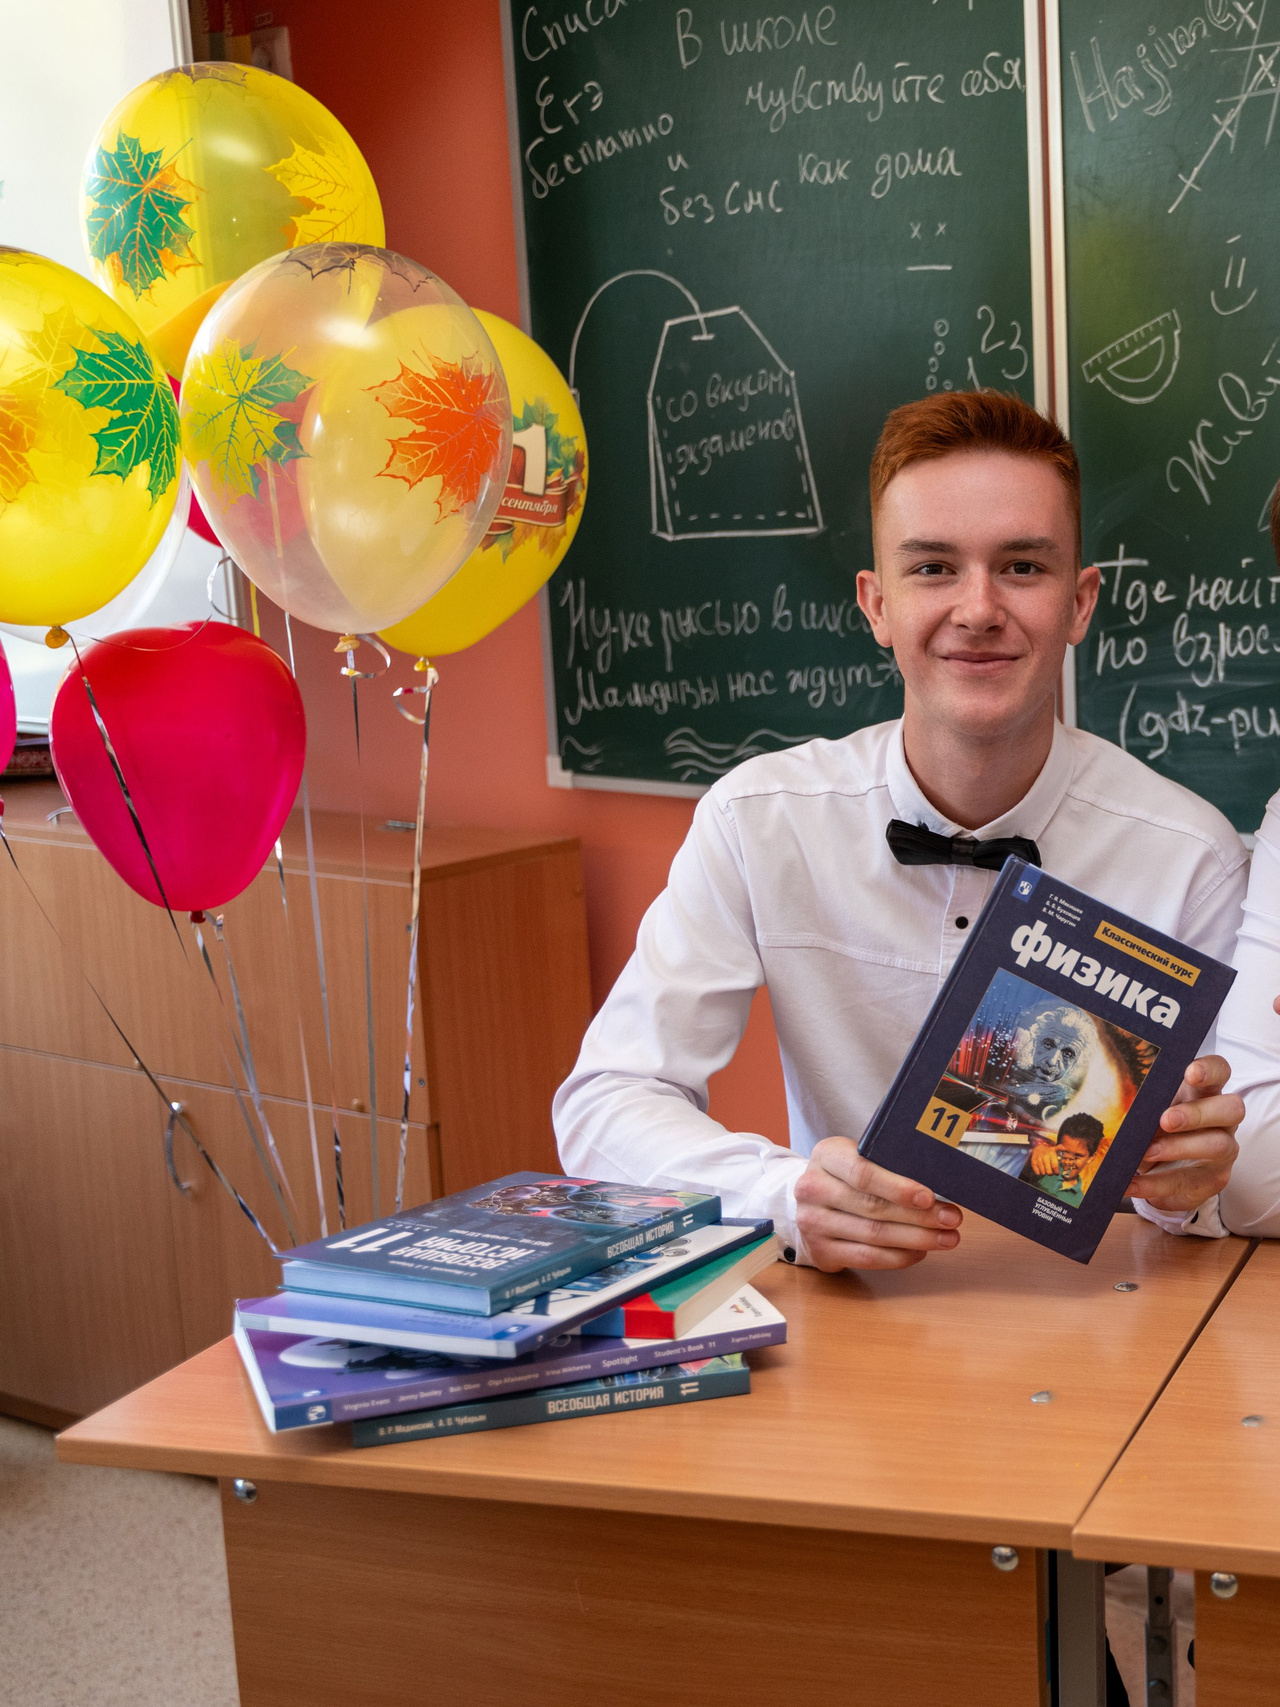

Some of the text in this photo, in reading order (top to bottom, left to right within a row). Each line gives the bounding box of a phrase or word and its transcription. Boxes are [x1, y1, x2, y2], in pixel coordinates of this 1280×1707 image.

[522, 0, 629, 61] Списа
[720, 4, 838, 56] школе
[746, 62, 945, 133] чувствуйте
[525, 113, 674, 199] бесплатно
[871, 146, 963, 199] дома
[659, 185, 715, 226] без
[666, 368, 784, 422] со вкусом
[675, 407, 797, 476] экзаменов
[501, 497, 559, 516] сентября
[659, 599, 761, 672] рысью
[771, 583, 794, 632] в
[800, 598, 874, 639] шко
[1097, 632, 1147, 676] по
[563, 662, 884, 725] Мальдивы нас ждут
[1010, 919, 1181, 1029] физика
[1101, 926, 1194, 980] Классический курс
[930, 1106, 961, 1139] 11
[325, 1227, 415, 1253] 11
[606, 1220, 675, 1259] ВСЕОБЩАЯ ИСТОРИЯ
[682, 1213, 694, 1228] 11
[388, 1246, 508, 1270] ВСЕОБЩАЯ
[413, 1236, 536, 1260] ИСТОРИЯ
[602, 1354, 639, 1369] Spotlight
[654, 1346, 687, 1358] Student's
[687, 1342, 705, 1353] Book
[708, 1341, 716, 1349] 11
[547, 1385, 664, 1415] ВСЕОБЩАЯ ИСТОРИЯ
[681, 1381, 700, 1397] 11
